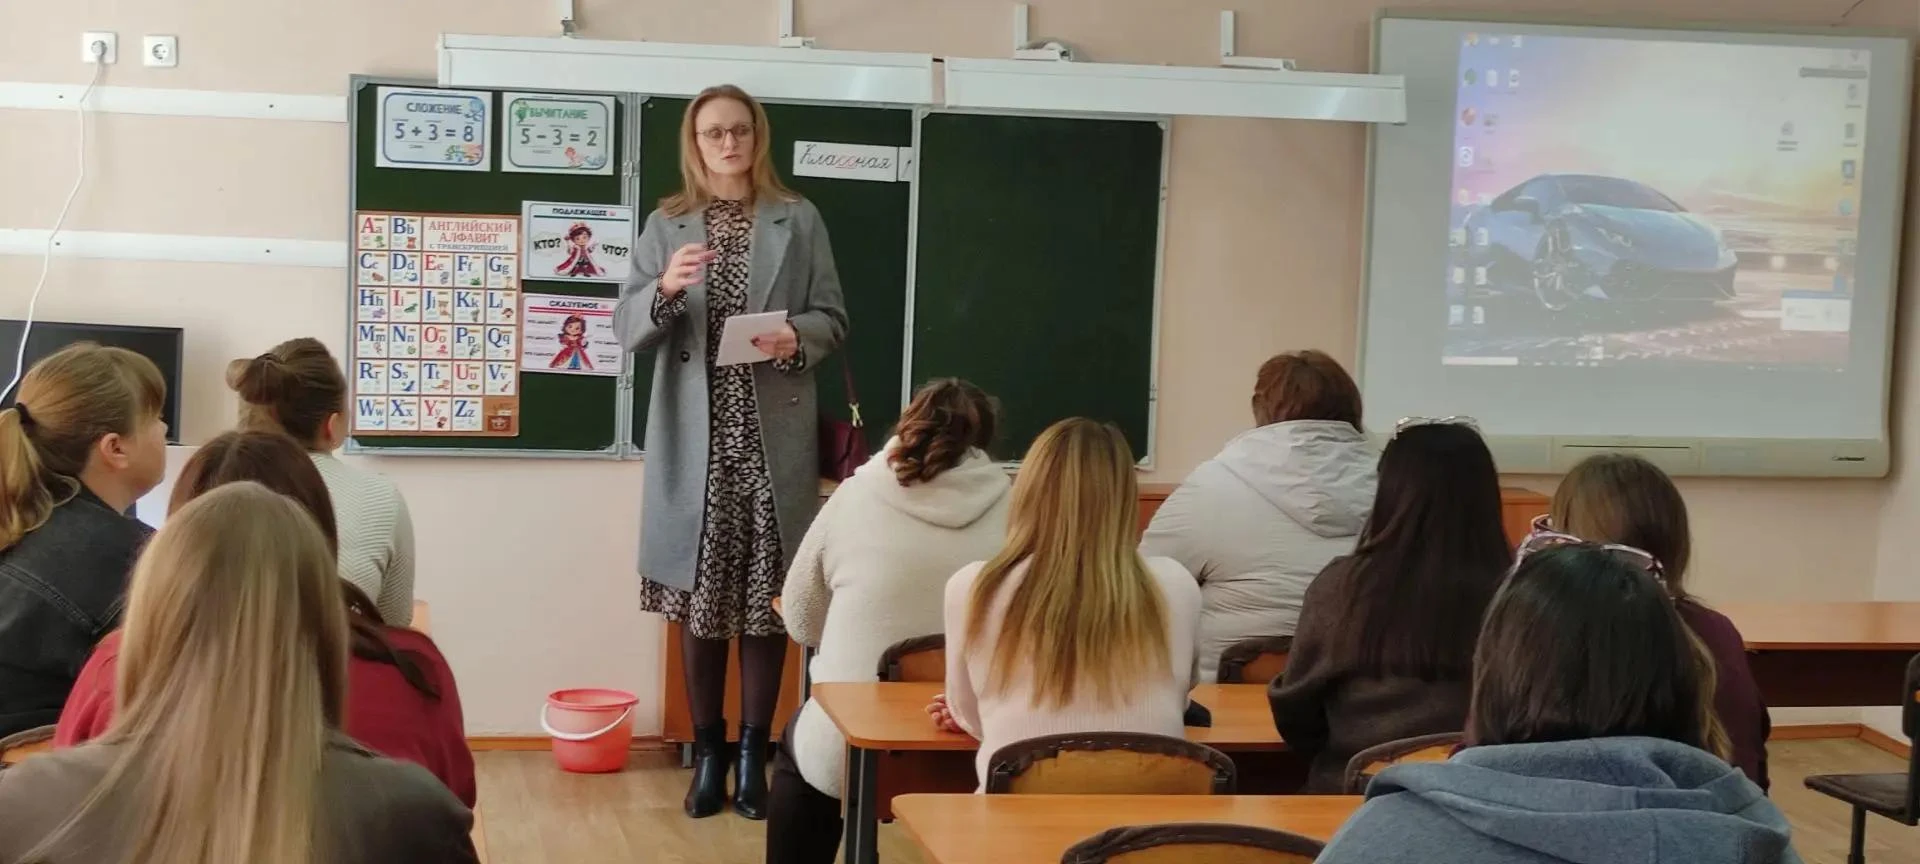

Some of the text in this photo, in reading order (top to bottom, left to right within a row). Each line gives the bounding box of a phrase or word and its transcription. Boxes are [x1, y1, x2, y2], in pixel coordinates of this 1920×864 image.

[407, 102, 462, 114] СЛОЖЕНИЕ
[530, 107, 588, 120] ВЫЧИТАНИЕ
[395, 122, 405, 139] 5
[428, 124, 438, 141] 3
[463, 125, 474, 142] 8
[520, 128, 530, 145] 5
[552, 129, 562, 146] 3
[586, 130, 597, 147] 2
[799, 144, 892, 169] Классная
[552, 207, 608, 217] ПОДЛЕЖАЩЕЕ
[428, 220, 513, 233] АНГЛИЙСКИЙ
[439, 232, 500, 243] АЛФАВИТ
[533, 238, 561, 251] КТО?
[602, 243, 629, 257] ЧТО?
[549, 300, 598, 309] СКАЗУЕМОЕ
